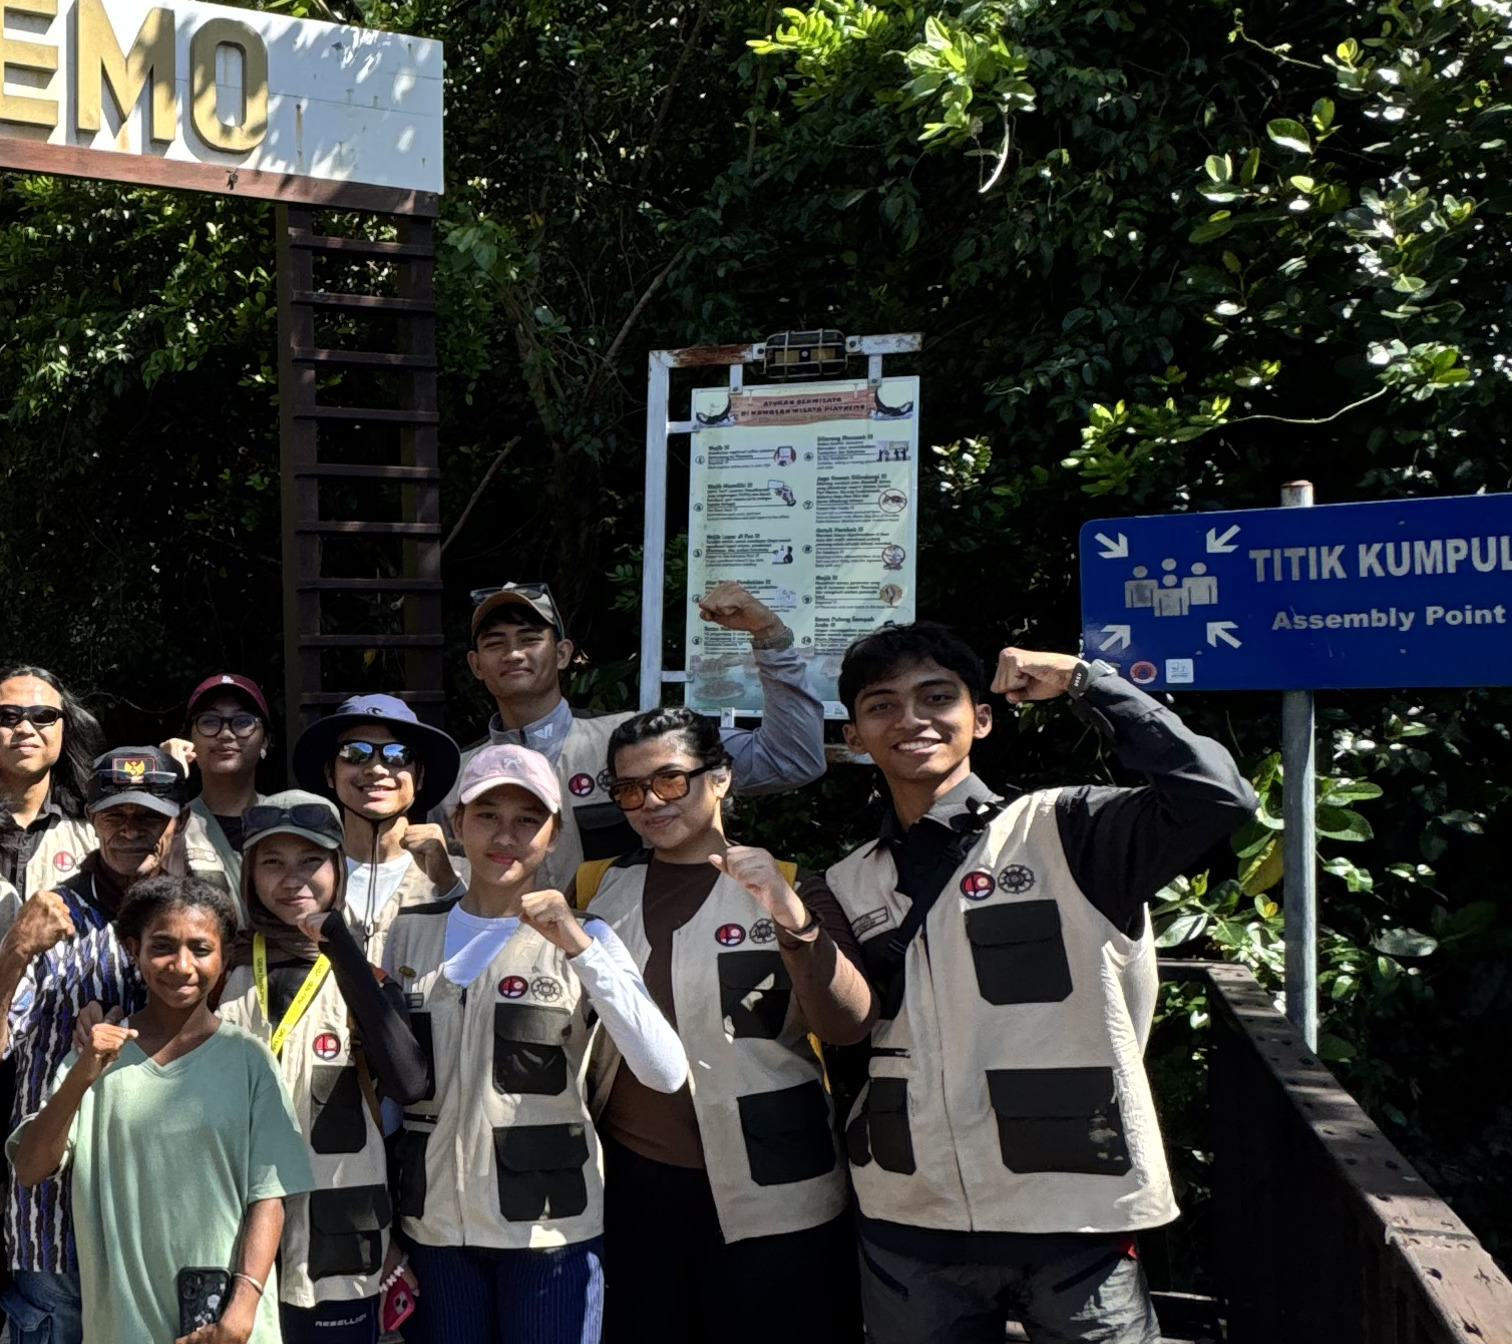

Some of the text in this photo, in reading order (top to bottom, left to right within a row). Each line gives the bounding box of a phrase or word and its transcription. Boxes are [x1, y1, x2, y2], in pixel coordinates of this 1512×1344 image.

[1249, 535, 1512, 582] TITIK KUMPUL
[1272, 604, 1507, 632] Assembly Point
